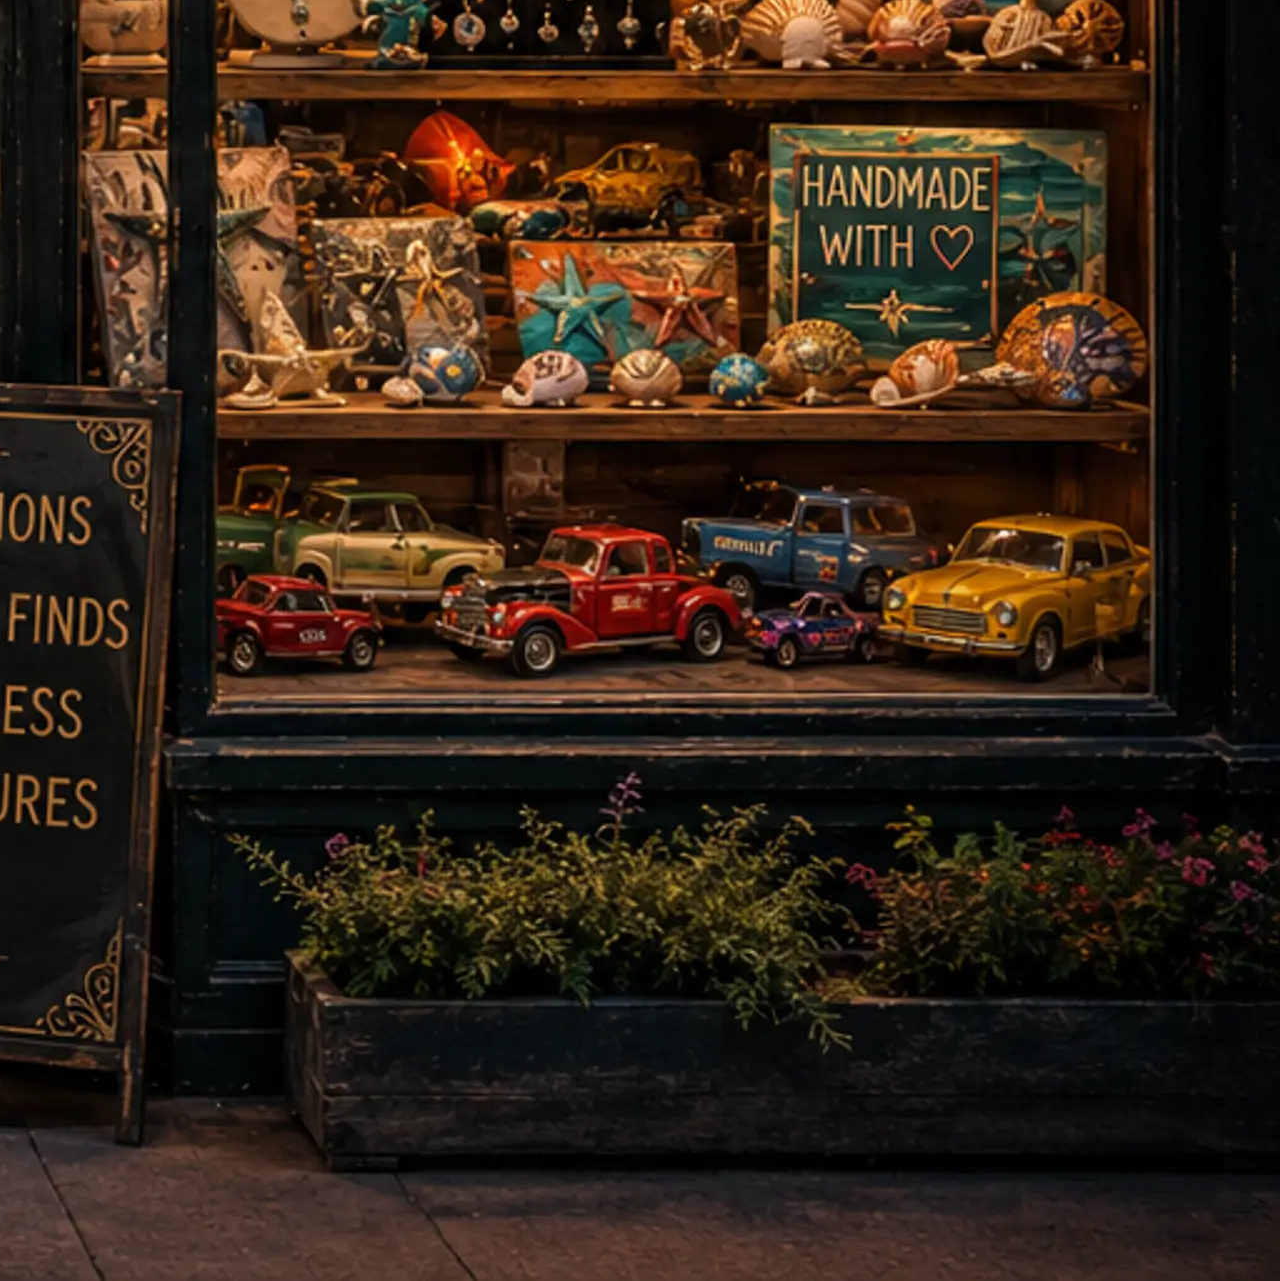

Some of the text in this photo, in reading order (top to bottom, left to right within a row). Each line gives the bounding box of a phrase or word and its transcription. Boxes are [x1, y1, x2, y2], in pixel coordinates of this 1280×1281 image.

[802, 164, 991, 211] HANDMADE
[819, 224, 913, 267] WITH
[8, 592, 129, 649] FINDS
